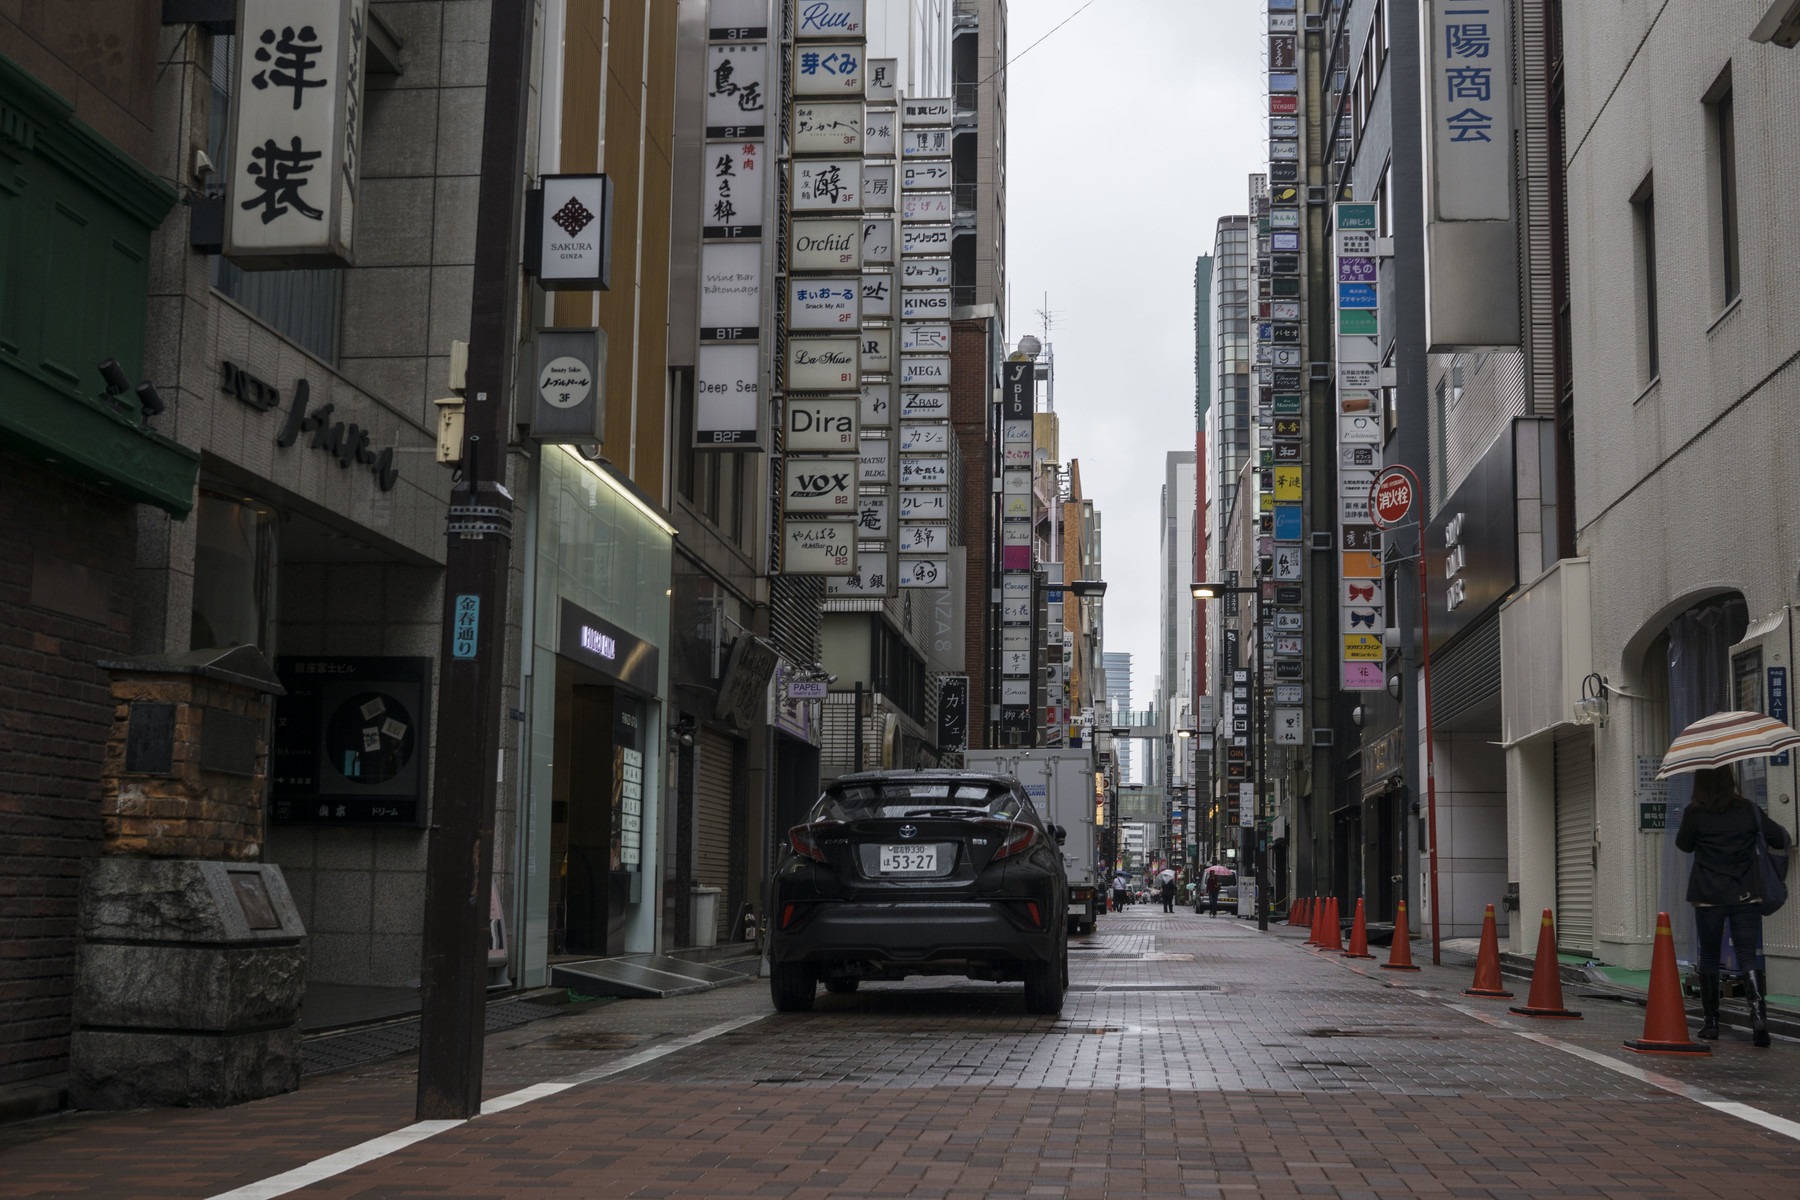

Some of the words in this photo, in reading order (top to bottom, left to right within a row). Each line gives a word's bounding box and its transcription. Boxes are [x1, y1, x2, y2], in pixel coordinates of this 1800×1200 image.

[801, 2, 851, 30] Ruu
[847, 23, 859, 32] 4F
[728, 29, 748, 39] 3F
[801, 52, 858, 76] 芽ぐみ
[844, 78, 857, 87] 4F
[872, 66, 893, 89] 見
[240, 24, 328, 226] 洋装
[725, 127, 746, 137] 2F
[843, 135, 856, 145] 3F
[742, 144, 756, 170] 焼肉
[905, 168, 948, 179] ローラン
[713, 154, 736, 224] 生き粋
[813, 165, 848, 205] 醇
[841, 194, 854, 203] 3F
[905, 201, 947, 213] むげん
[723, 228, 742, 238] 1F
[551, 242, 593, 252] SAKURA
[796, 232, 855, 252] Orchid
[560, 252, 584, 260] GINZA
[839, 254, 853, 263] 2F
[1341, 264, 1373, 274] きもの
[707, 273, 733, 282] Wine
[736, 273, 755, 281] Bar
[904, 298, 947, 308] KINGS
[838, 313, 852, 322] 2F
[716, 328, 742, 339] B1F
[818, 351, 853, 365] Muse
[907, 366, 943, 376] MEGA
[840, 373, 852, 382] B1
[699, 380, 728, 395] Deep
[736, 380, 757, 392] Sea
[559, 392, 571, 402] 3F
[791, 409, 853, 433] Dira
[713, 432, 741, 443] B2F
[840, 434, 851, 443] B1
[834, 495, 848, 504] B2
[901, 497, 945, 509] クレール
[1378, 486, 1409, 510] 消火栓
[859, 508, 882, 530] 庵
[825, 545, 848, 557] RIO
[834, 556, 848, 566] B2
[934, 570, 952, 652] NZA8
[458, 597, 476, 656] 金春通り
[1359, 667, 1369, 676] 花
[793, 683, 822, 692] PAPEL
[1772, 677, 1784, 718] 銀座八丁
[945, 692, 961, 734] カシェ
[910, 845, 925, 853] 330
[892, 855, 934, 869] 53-27
